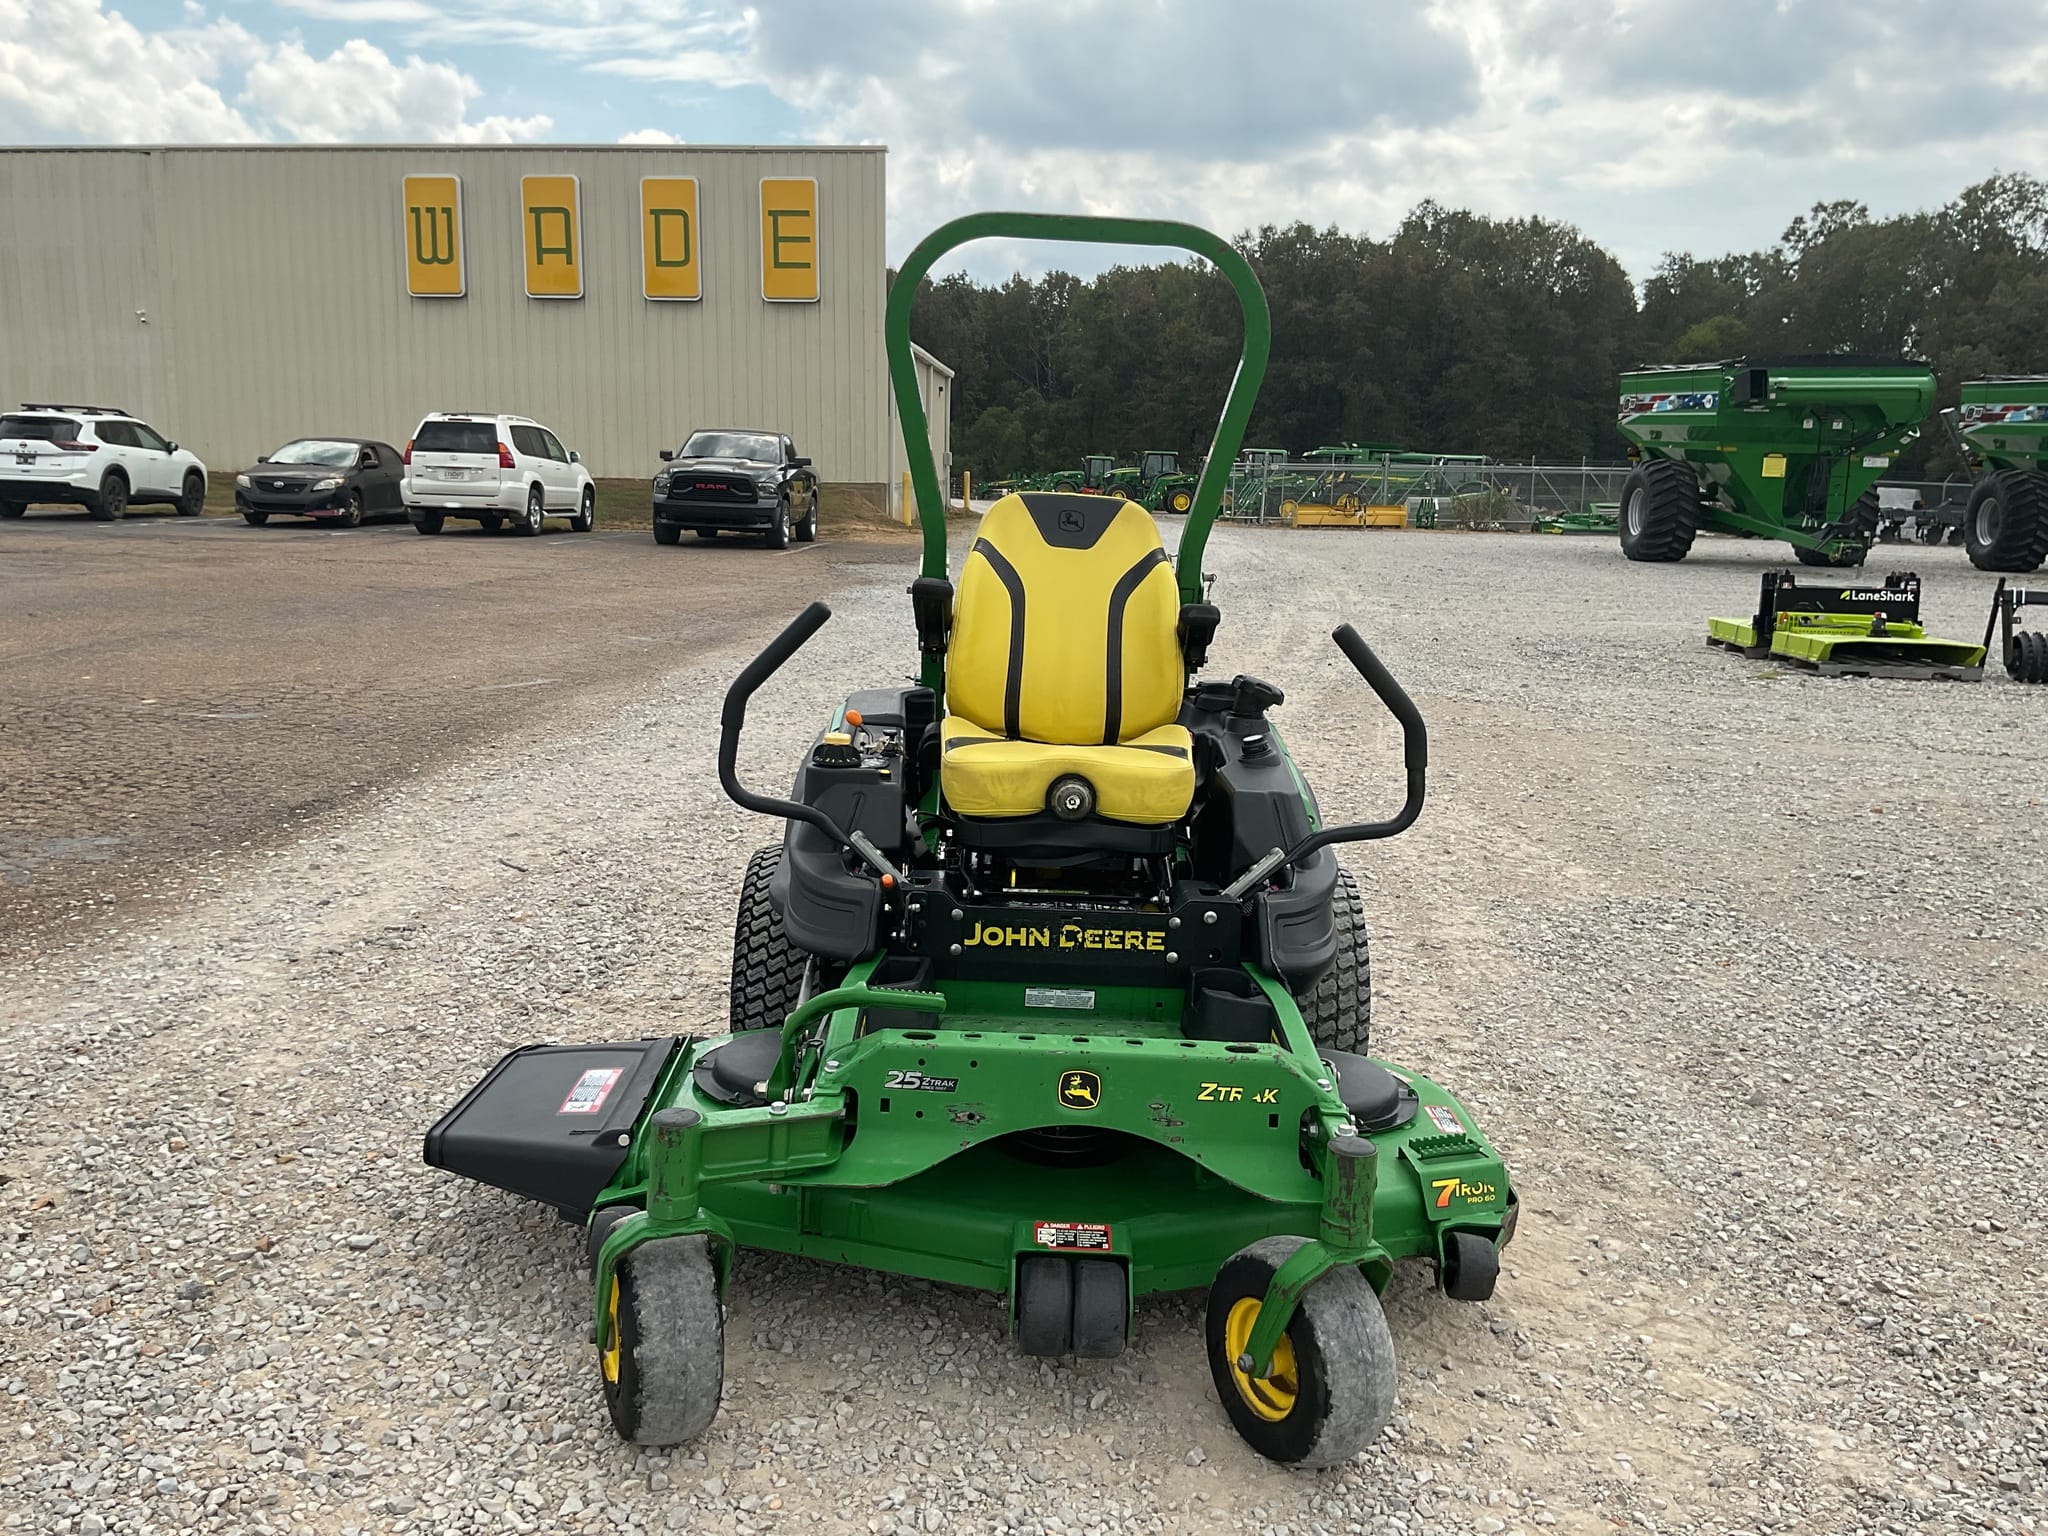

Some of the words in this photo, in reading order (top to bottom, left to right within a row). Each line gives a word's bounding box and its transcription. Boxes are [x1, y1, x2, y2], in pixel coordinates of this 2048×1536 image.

[409, 206, 811, 269] WADE
[1851, 589, 1914, 602] LaneShark
[964, 922, 1050, 946] JOHN
[1060, 924, 1166, 950] DEERE
[884, 1070, 922, 1089] 25
[921, 1077, 955, 1088] ZTRAK
[1431, 1178, 1460, 1208] 7
[1455, 1181, 1495, 1197] IRON
[1467, 1196, 1483, 1204] PRO
[1484, 1194, 1496, 1202] 60
